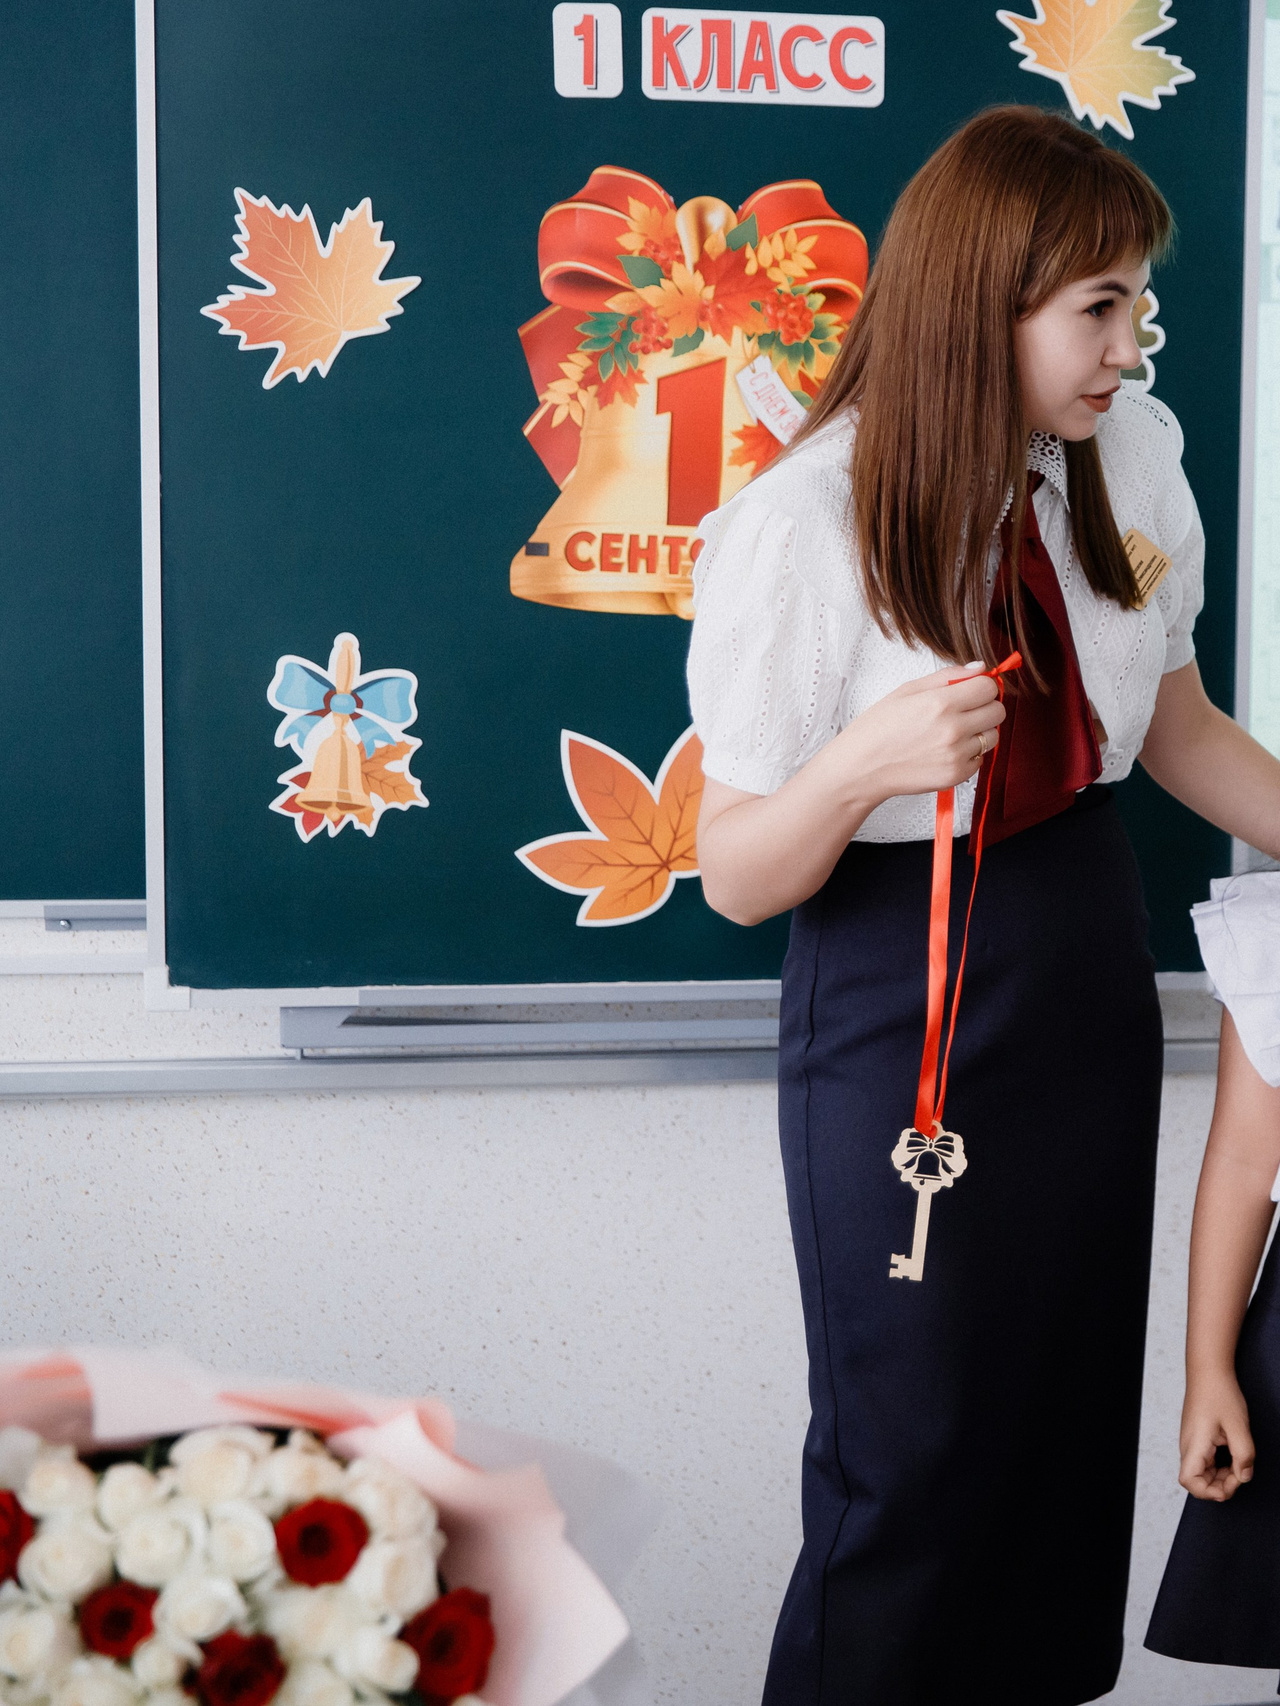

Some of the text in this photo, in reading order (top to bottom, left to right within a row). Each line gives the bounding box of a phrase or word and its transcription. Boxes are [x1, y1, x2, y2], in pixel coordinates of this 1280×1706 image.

[573, 13, 877, 93] 1 КЛАСС
[655, 357, 727, 528] 1
